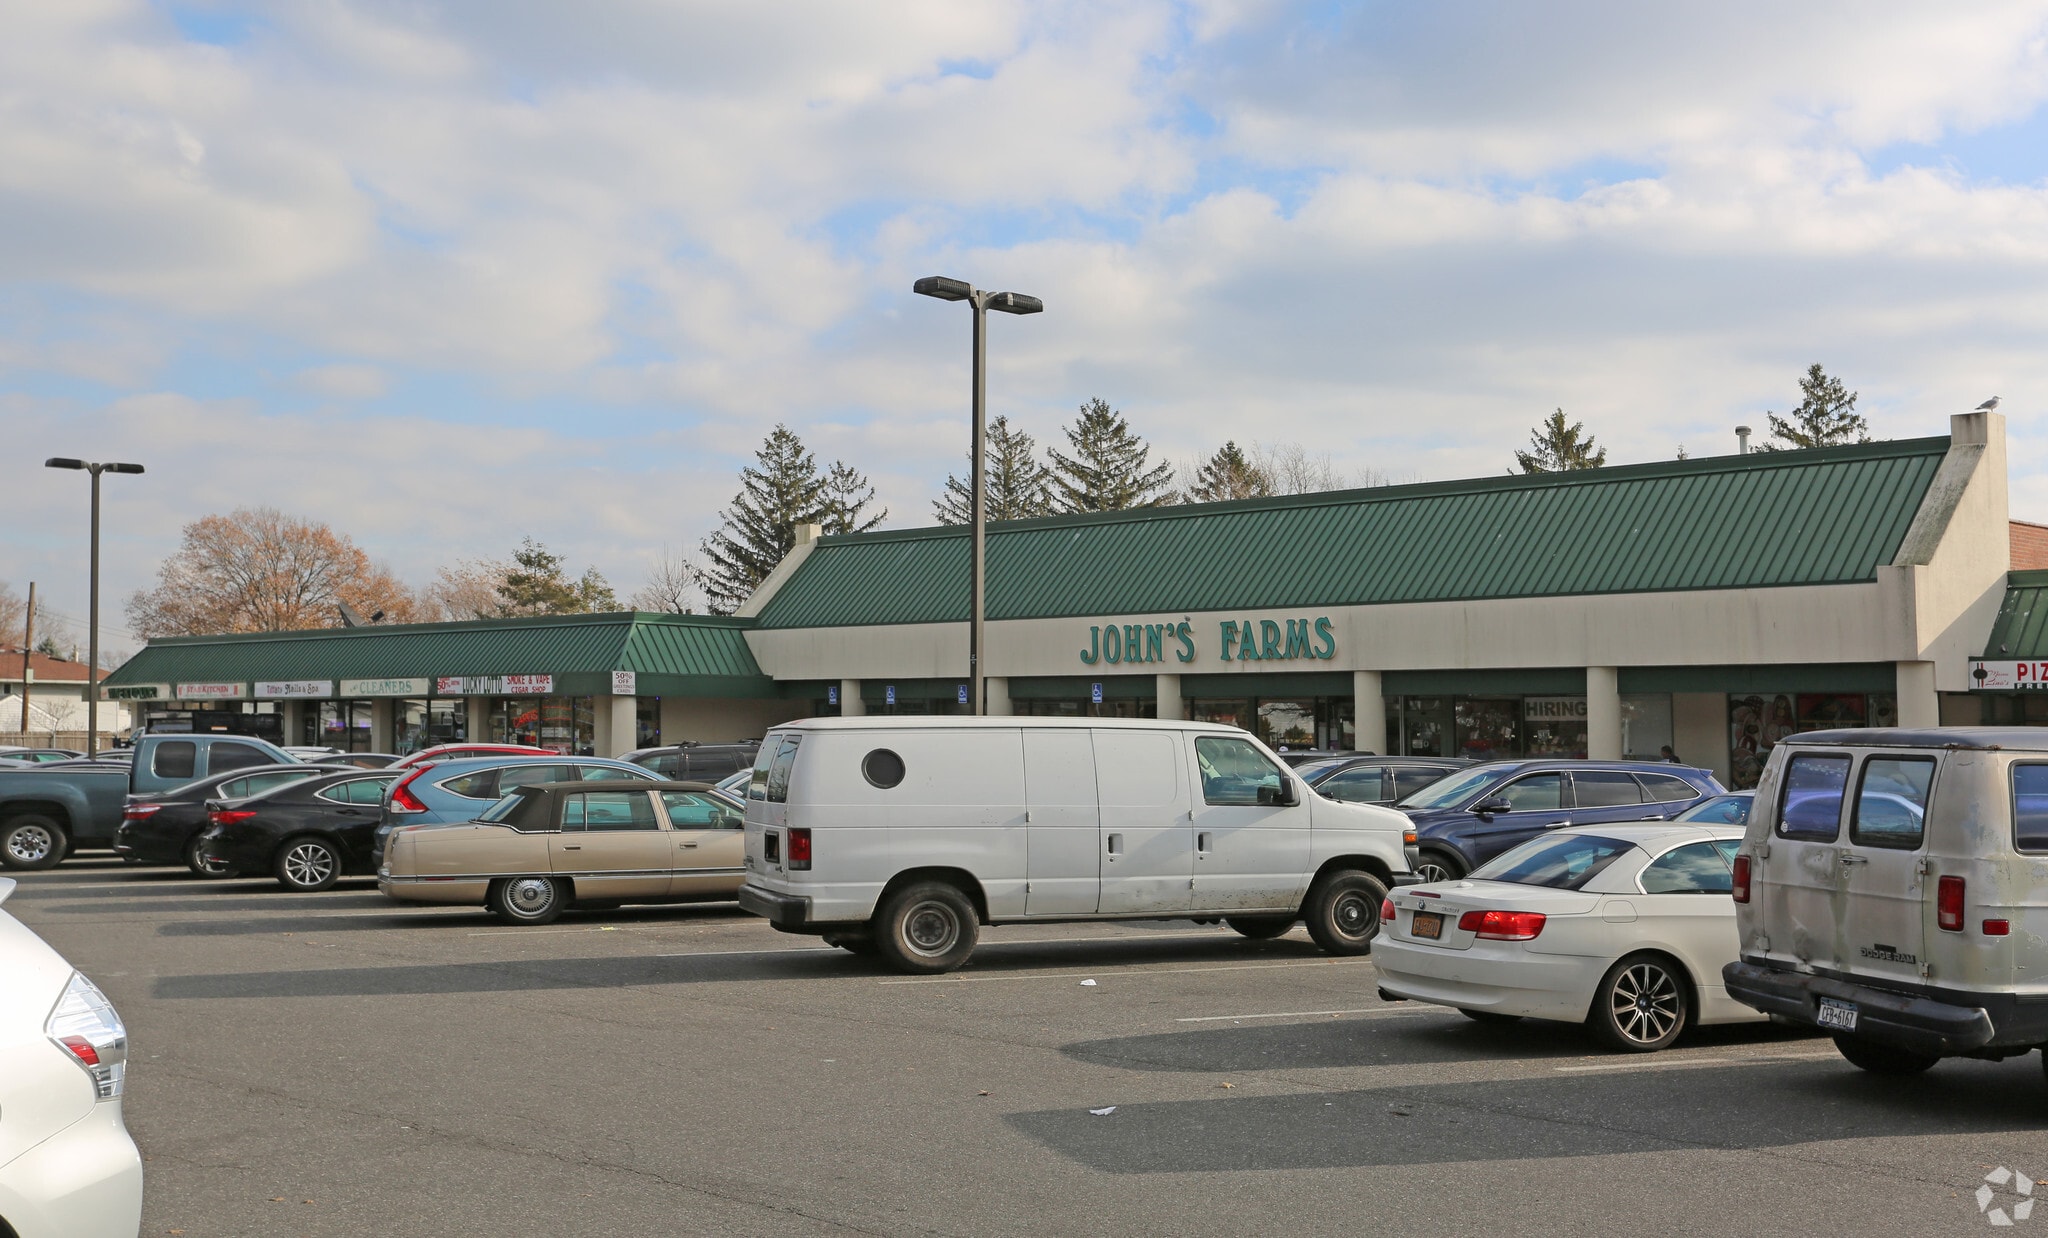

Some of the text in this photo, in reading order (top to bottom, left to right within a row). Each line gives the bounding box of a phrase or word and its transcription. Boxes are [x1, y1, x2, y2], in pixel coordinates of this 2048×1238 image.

[1080, 616, 1336, 665] JOHN'S FARMS
[507, 674, 550, 684] SMOKE & VAPE
[615, 672, 633, 680] 50%
[201, 685, 229, 693] KITCHEN
[307, 683, 319, 694] Spa
[360, 681, 413, 694] CLEANERS
[463, 675, 502, 694] LUCKY LOTTO
[511, 685, 546, 694] CIGAR SHOP
[1525, 701, 1588, 717] HIRING
[1859, 947, 1916, 965] DODGE RAM
